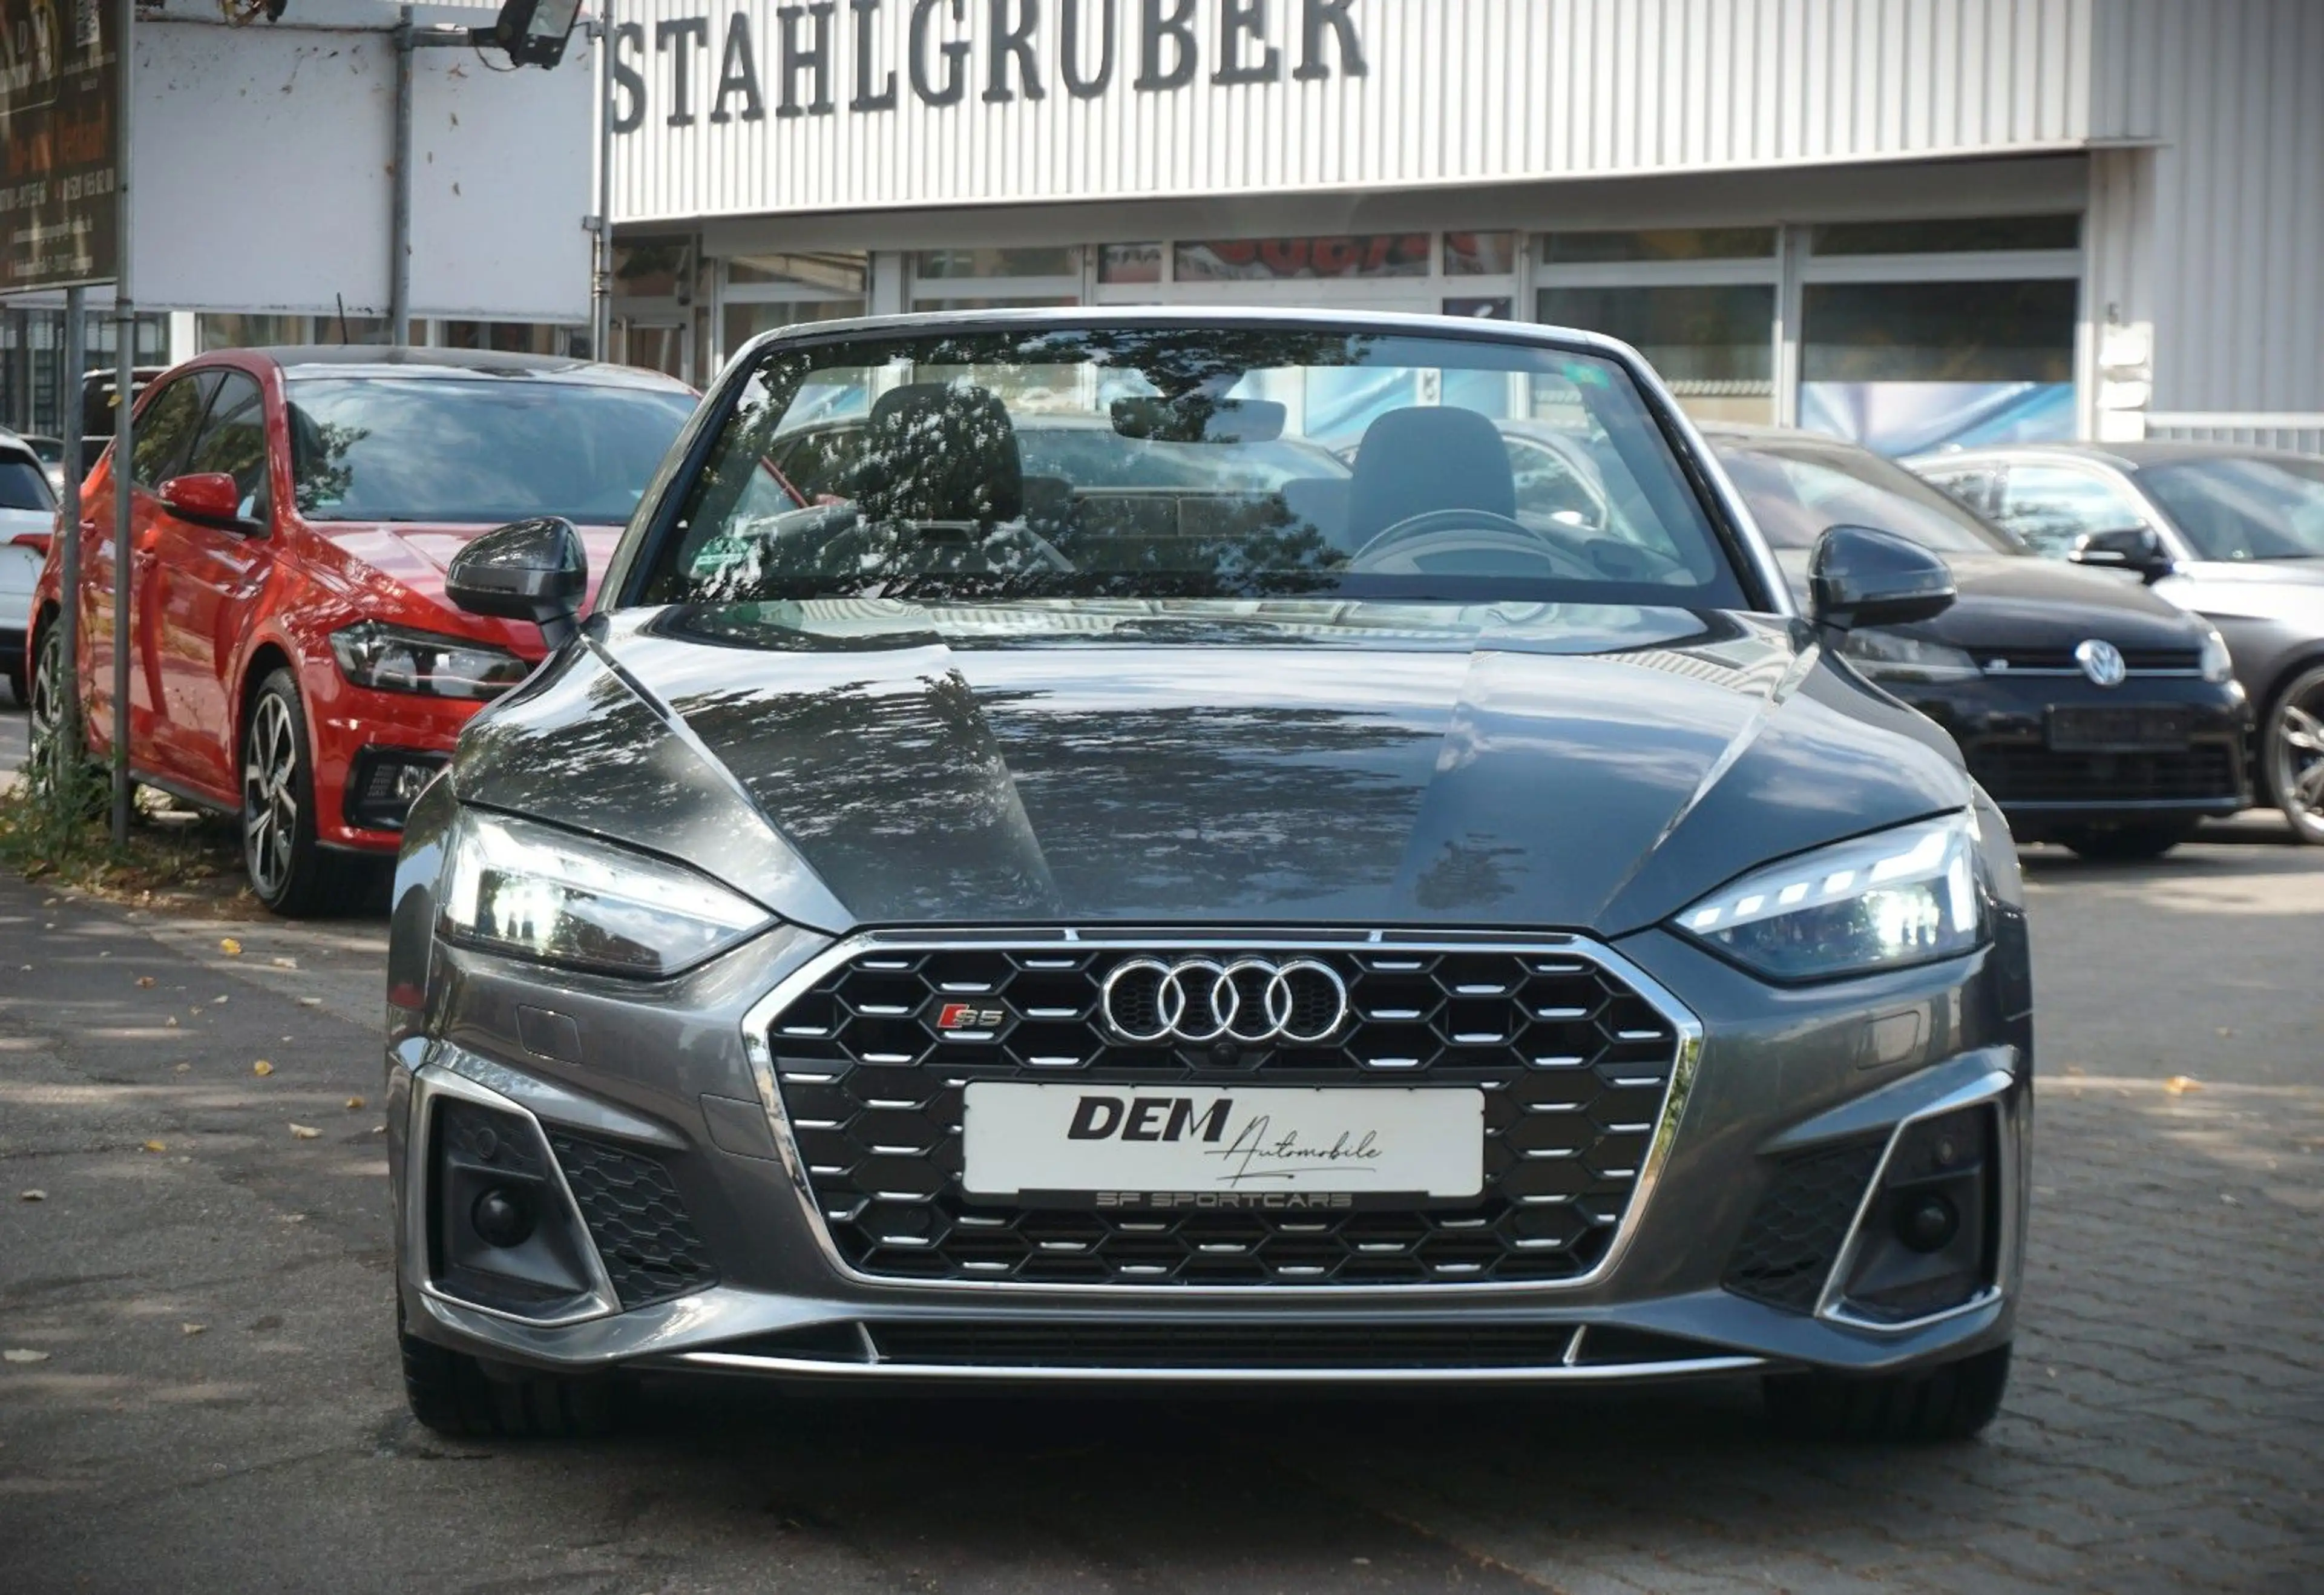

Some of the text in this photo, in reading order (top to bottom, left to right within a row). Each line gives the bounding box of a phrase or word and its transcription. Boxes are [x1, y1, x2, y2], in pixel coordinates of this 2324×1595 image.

[611, 0, 1368, 134] STAHLGRUBER
[952, 1008, 1004, 1027] S5
[1067, 1096, 1233, 1142] DEM
[1204, 1114, 1383, 1188] Automobile
[1096, 1191, 1353, 1208] SF SPORTCARS
